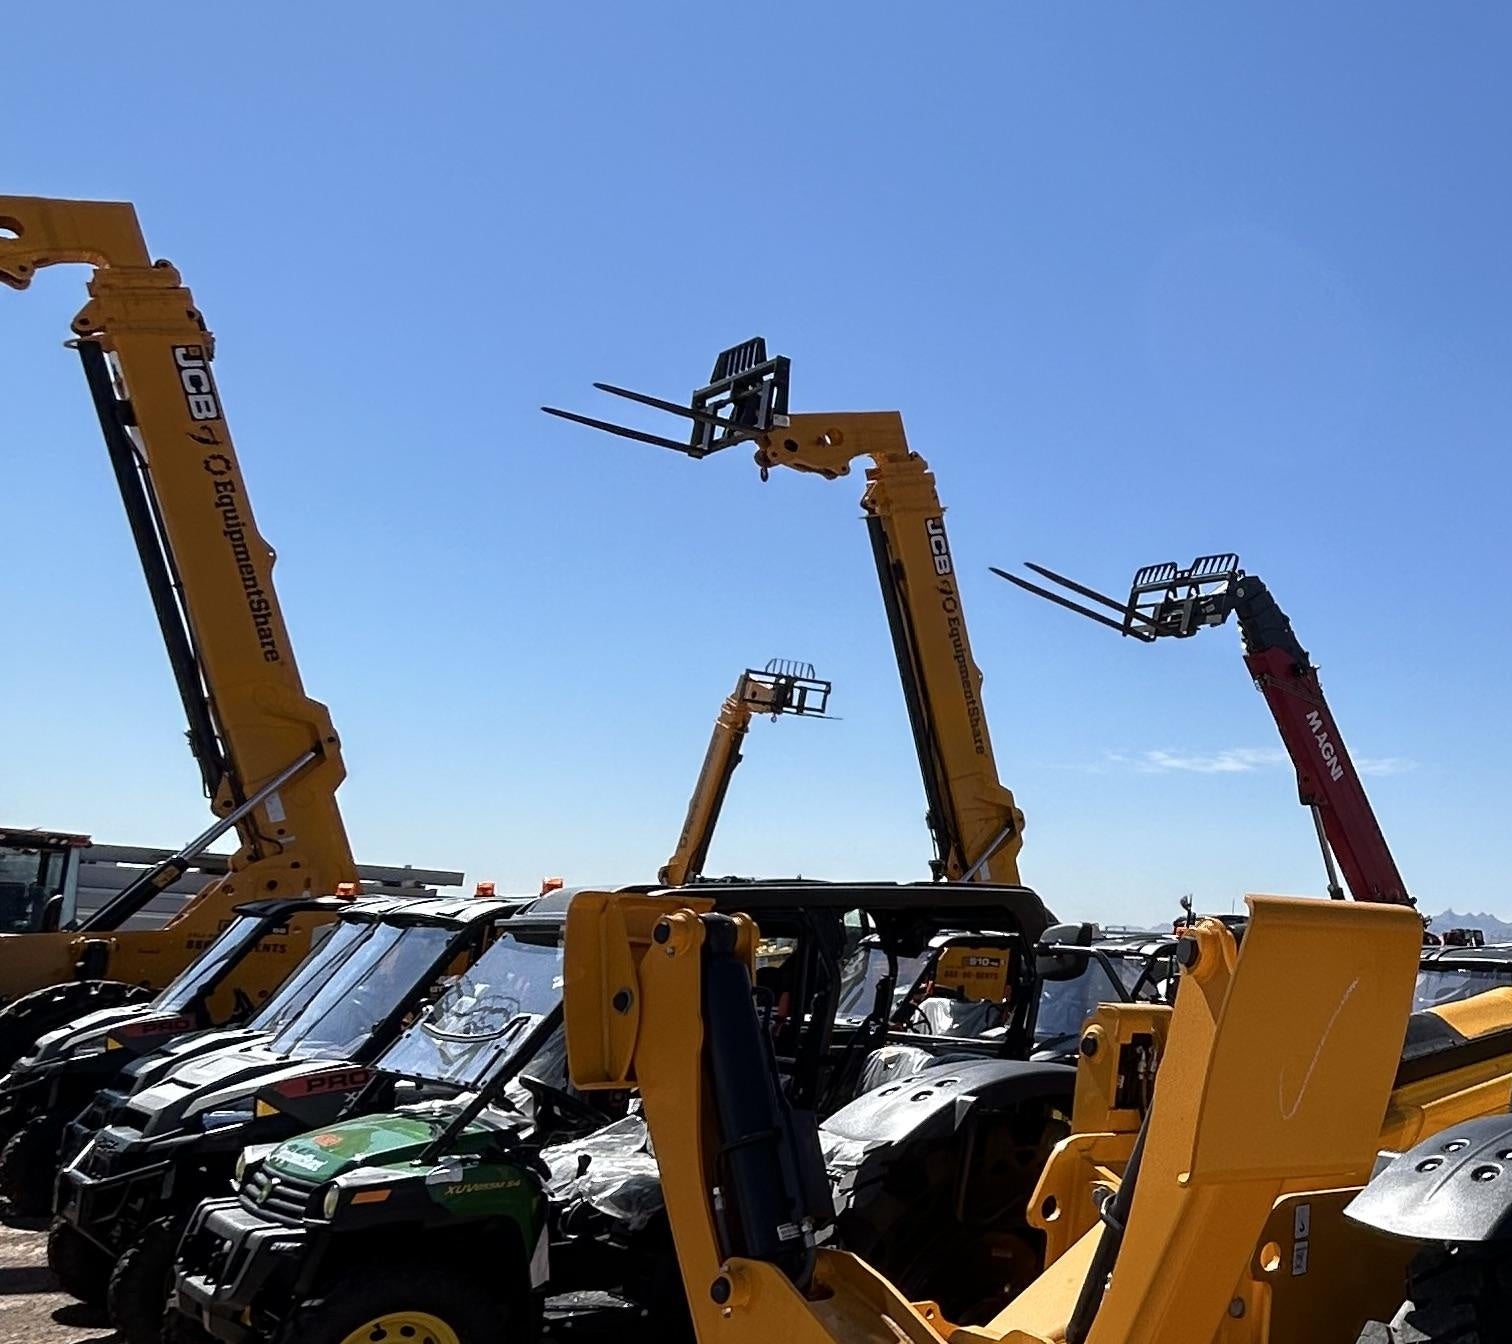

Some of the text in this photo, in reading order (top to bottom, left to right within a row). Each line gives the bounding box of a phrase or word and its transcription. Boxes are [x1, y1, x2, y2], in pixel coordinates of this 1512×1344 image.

[175, 345, 219, 421] JCB
[213, 478, 280, 664] EquipmentShare
[926, 518, 951, 576] JCB
[948, 615, 986, 755] EquipmentShare
[1305, 710, 1344, 782] MAGNI
[306, 1069, 370, 1093] PRO
